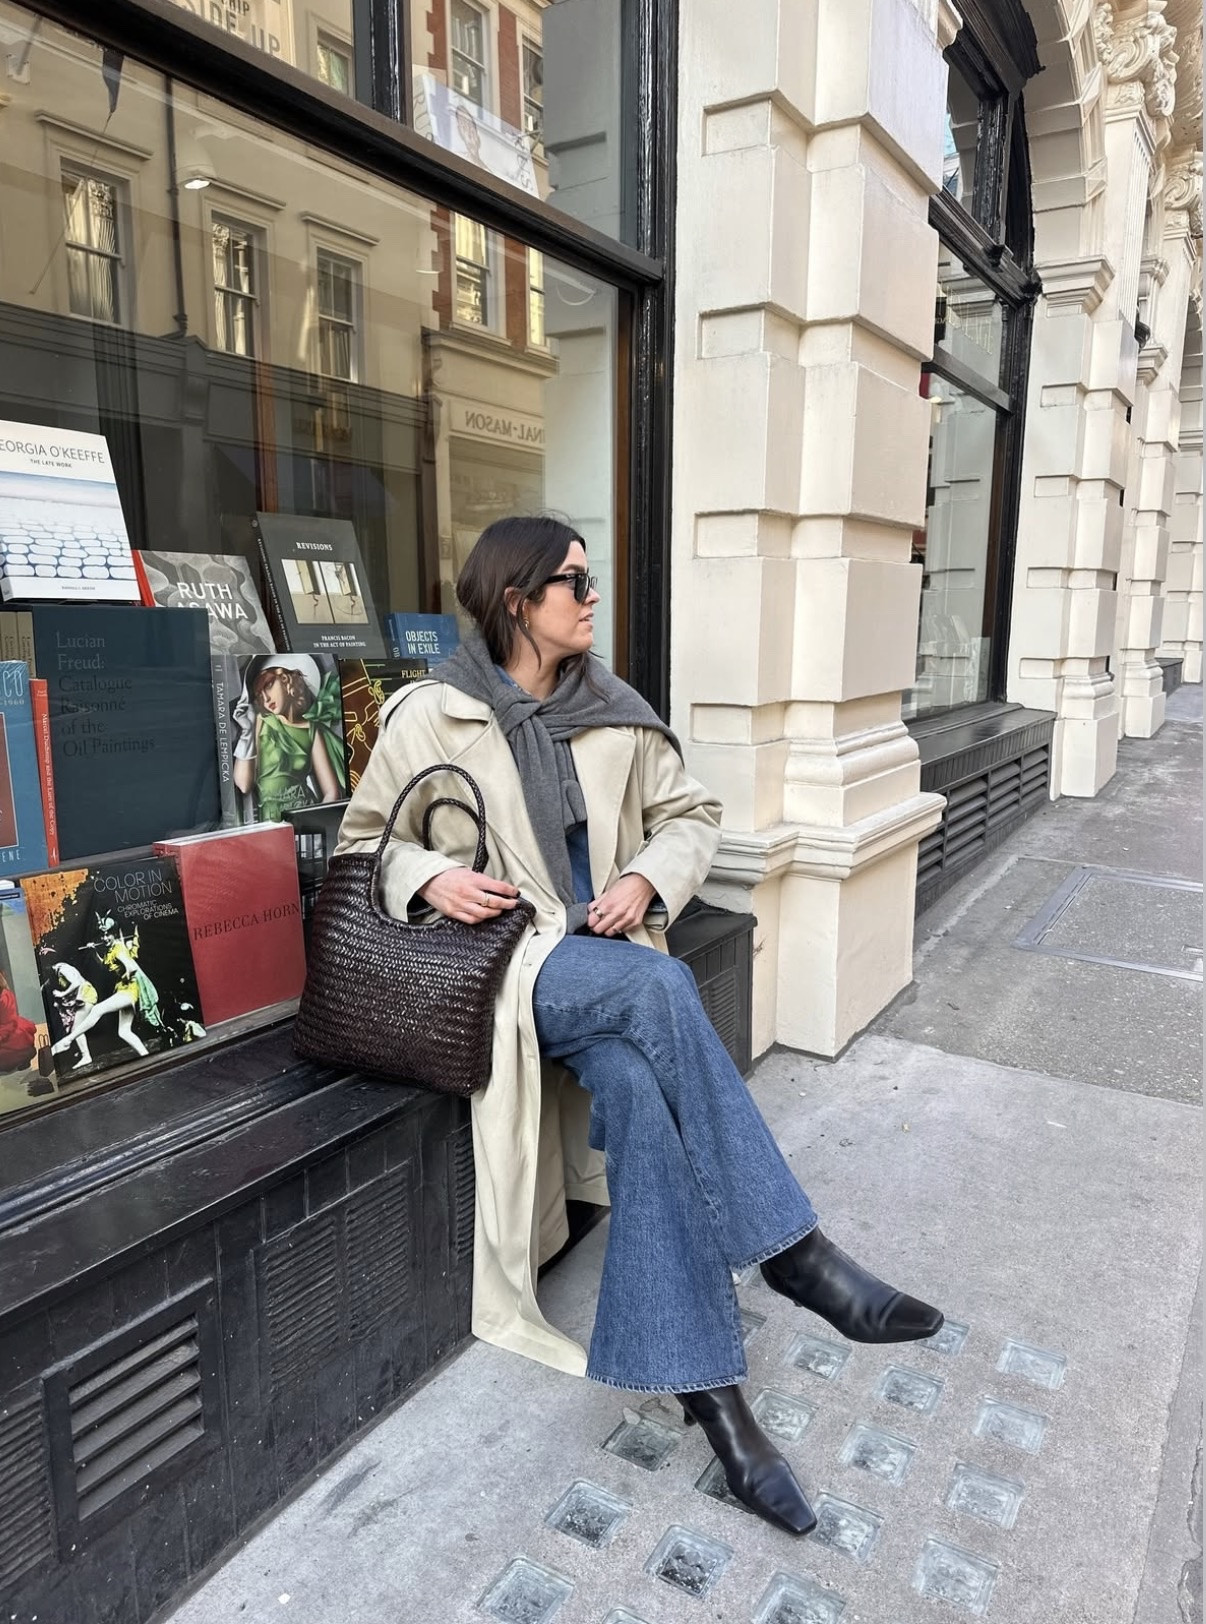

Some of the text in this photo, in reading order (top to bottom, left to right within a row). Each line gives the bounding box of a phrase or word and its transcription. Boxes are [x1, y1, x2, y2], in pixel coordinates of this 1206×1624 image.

[49, 446, 105, 463] O'KEEFFE
[296, 542, 333, 551] REVISIONS
[177, 582, 233, 600] RUTH
[56, 631, 105, 648] Lucian
[405, 630, 439, 642] OBJECTS
[407, 643, 441, 655] IN EXILE
[57, 653, 105, 670] Freud:
[58, 675, 132, 694] Catalogue
[215, 682, 225, 719] TAMARA
[61, 718, 105, 735] of the
[218, 721, 227, 735] DE
[63, 737, 155, 757] Oil Paintings
[219, 736, 230, 783] LEMPICKA
[94, 868, 163, 893] COLOR IN
[114, 881, 173, 904] MOTION
[117, 899, 158, 913] CHROMATIC
[124, 902, 173, 918] EXPLORATIONS
[143, 908, 180, 921] OF CINEMA
[193, 902, 300, 941] REBECCA HORN
